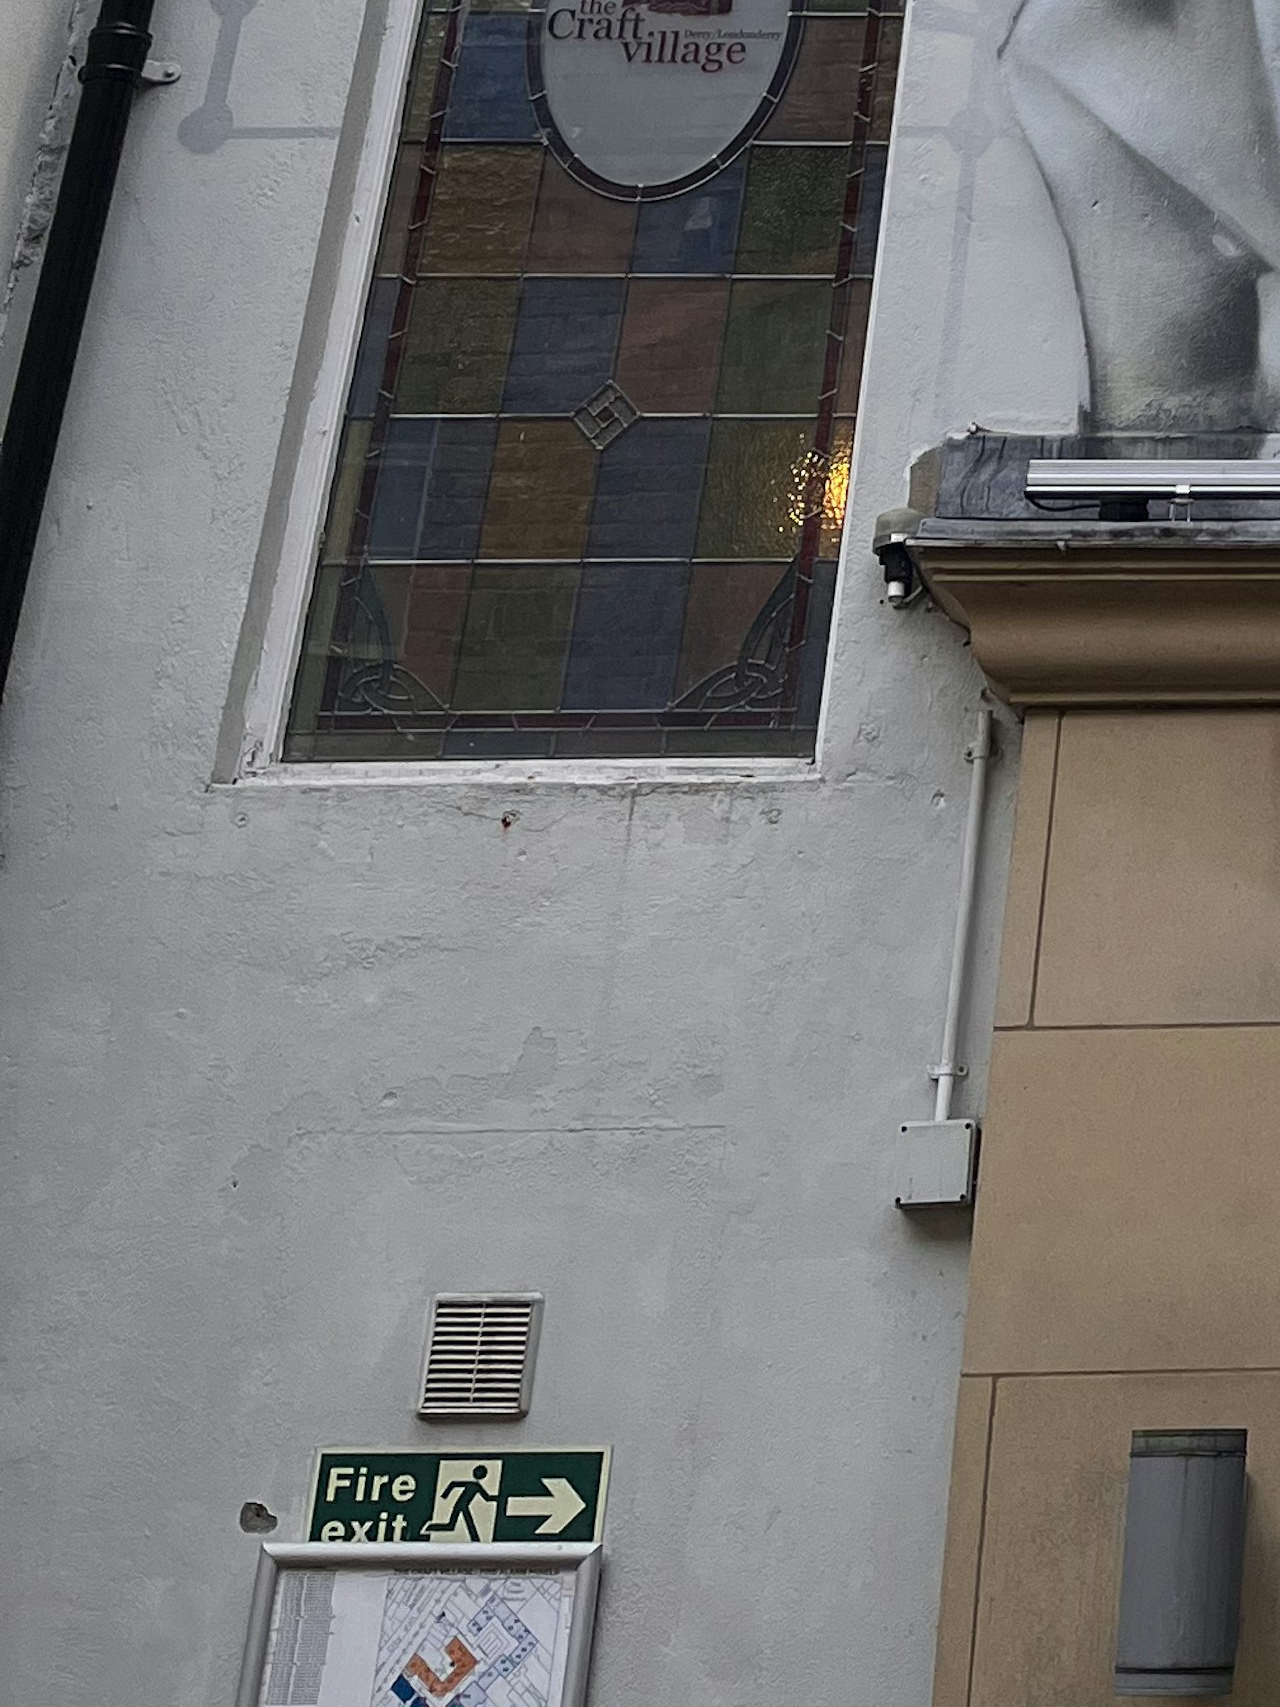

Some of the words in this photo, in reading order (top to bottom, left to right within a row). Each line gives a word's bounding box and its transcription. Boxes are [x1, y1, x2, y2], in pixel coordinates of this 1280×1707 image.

[547, 7, 646, 41] Craft
[621, 30, 747, 73] village
[325, 1467, 416, 1502] Fire
[320, 1511, 408, 1542] exit
